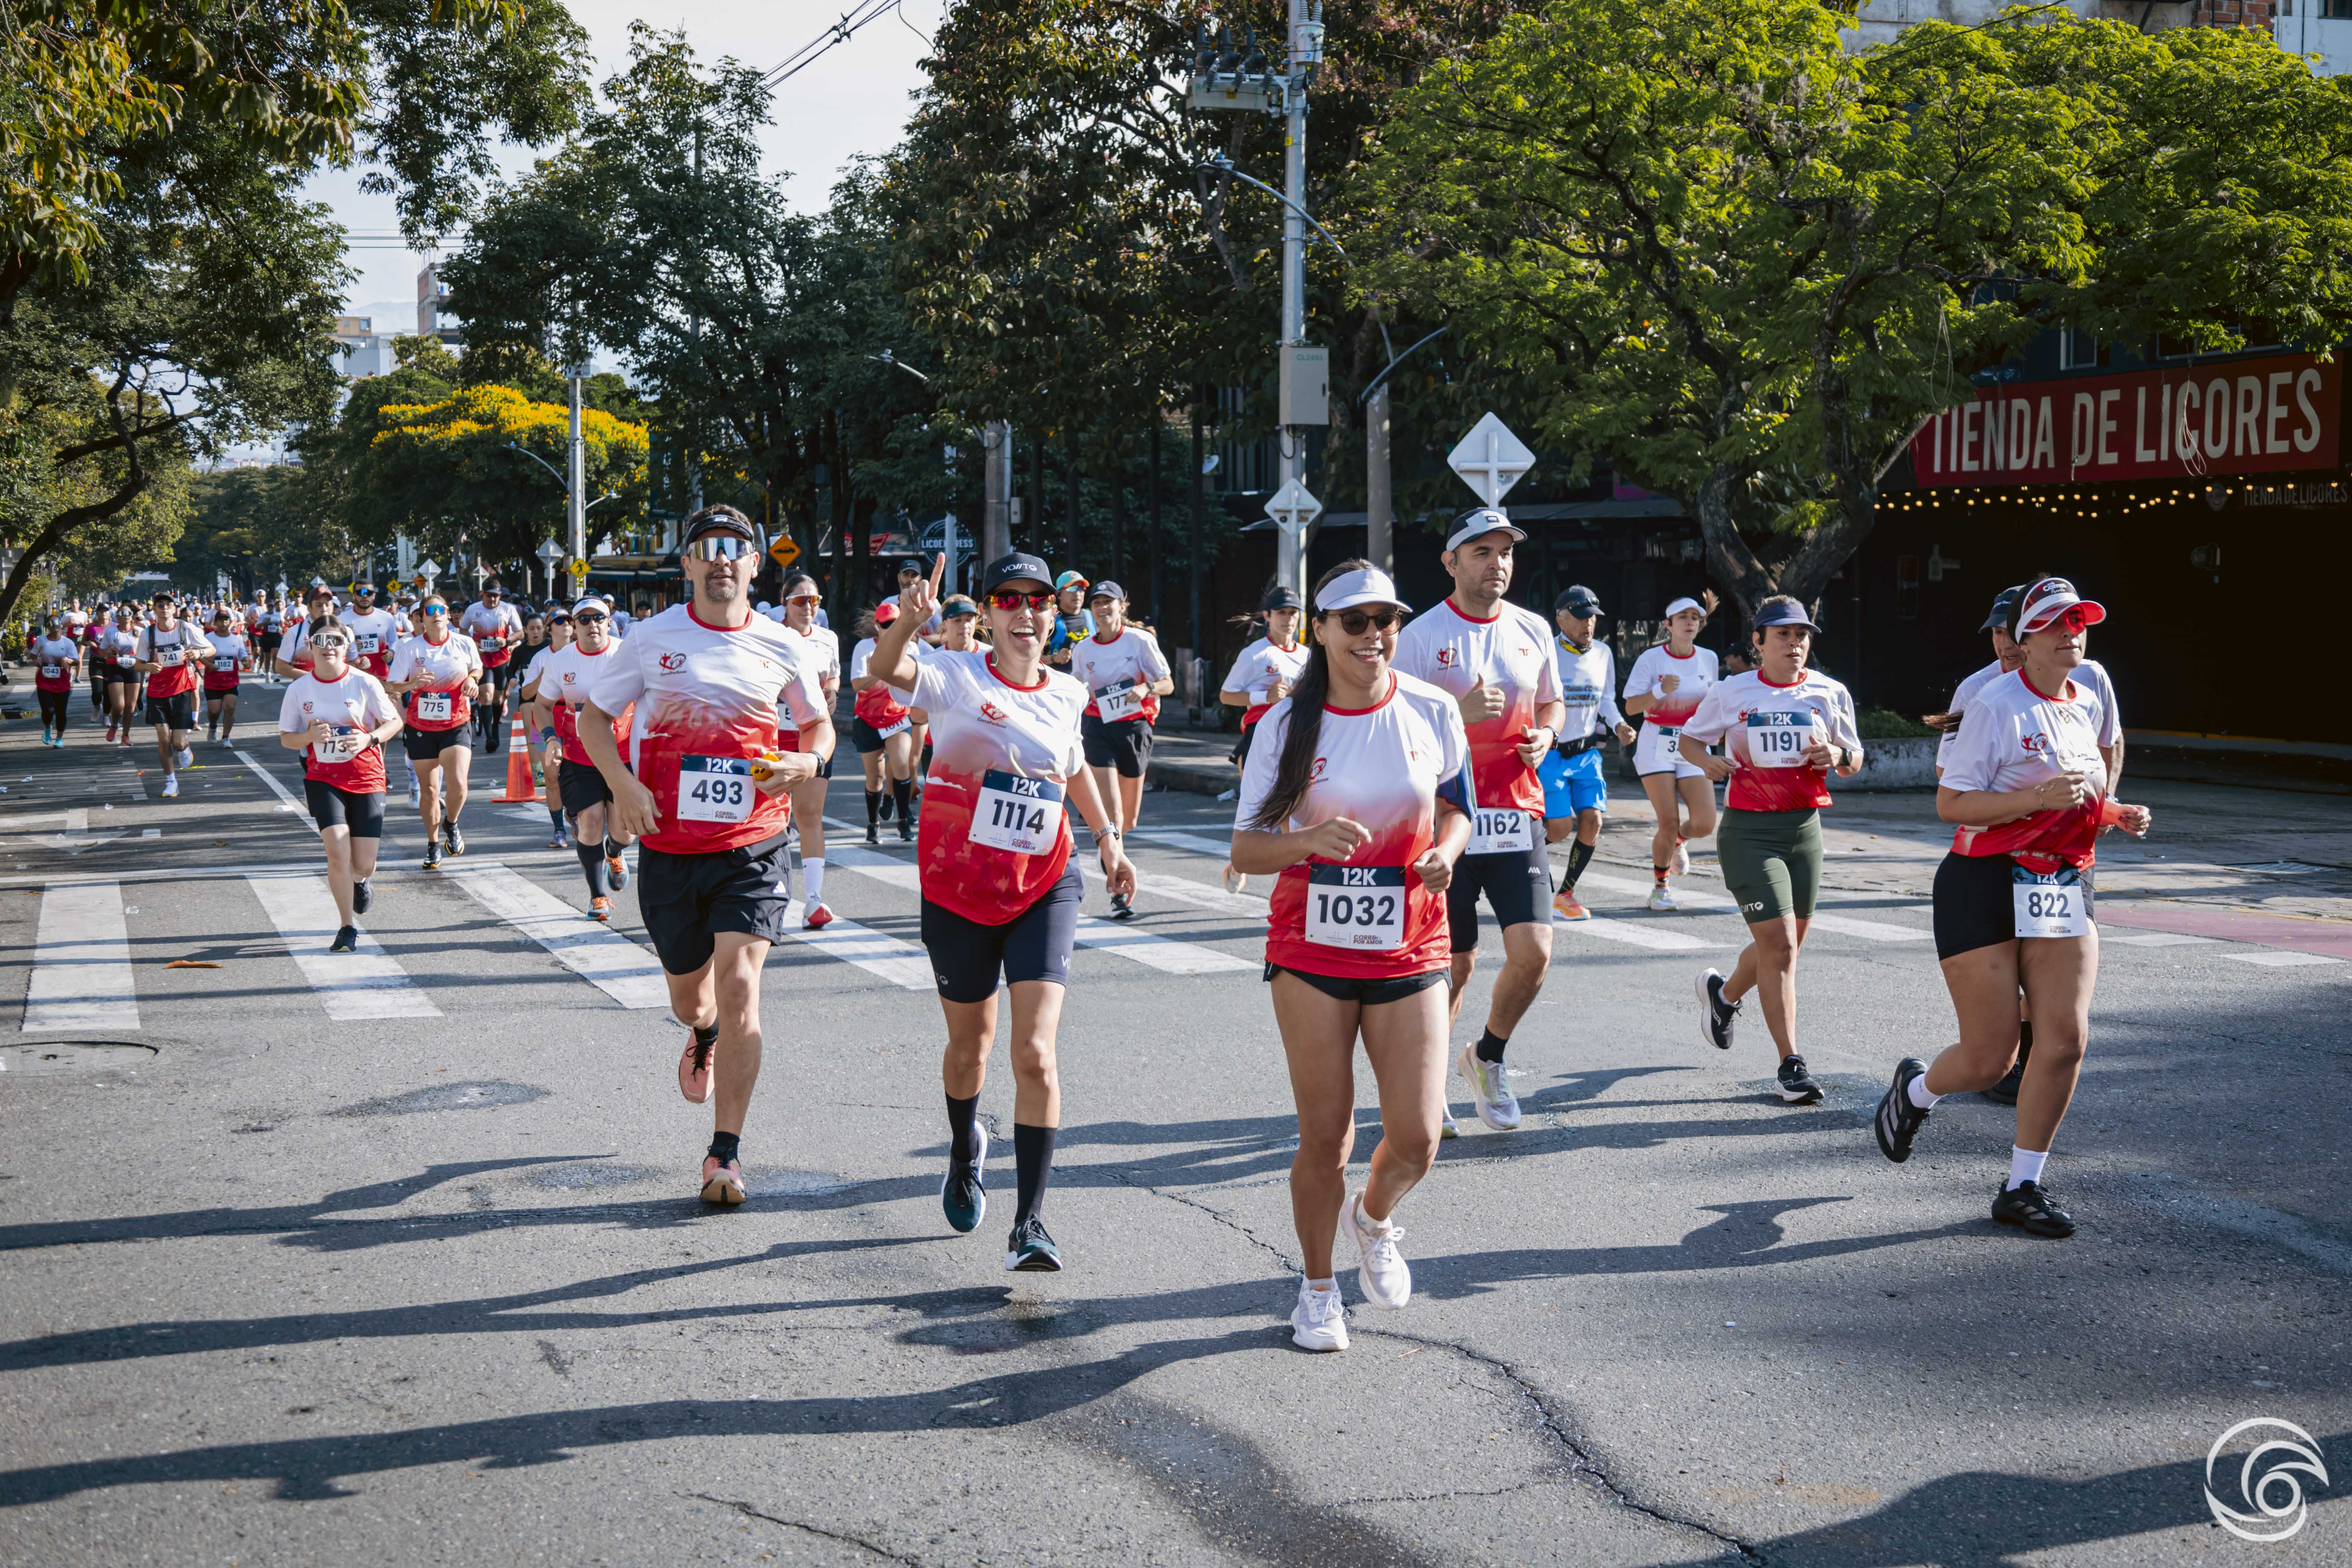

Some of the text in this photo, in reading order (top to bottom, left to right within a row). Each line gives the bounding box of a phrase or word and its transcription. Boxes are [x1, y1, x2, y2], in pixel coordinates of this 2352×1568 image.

[1933, 368, 2322, 473] TIENDA DE LICORES
[2243, 483, 2348, 506] TIENDA DE LICORES
[163, 653, 177, 662] 741
[1106, 683, 1122, 694] 12K
[424, 701, 444, 712] 775
[1768, 713, 1793, 725] 12K
[1672, 728, 1681, 737] 12
[1760, 731, 1801, 752] 1191
[706, 758, 734, 773] 12K
[692, 779, 743, 805] 493
[1012, 777, 1041, 797] 12K
[992, 798, 1045, 834] 1114
[1475, 812, 1521, 836] 1162
[1342, 868, 1377, 886] 12K
[2037, 871, 2059, 884] 12K
[1318, 894, 1395, 926] 1032
[2029, 892, 2071, 917] 822
